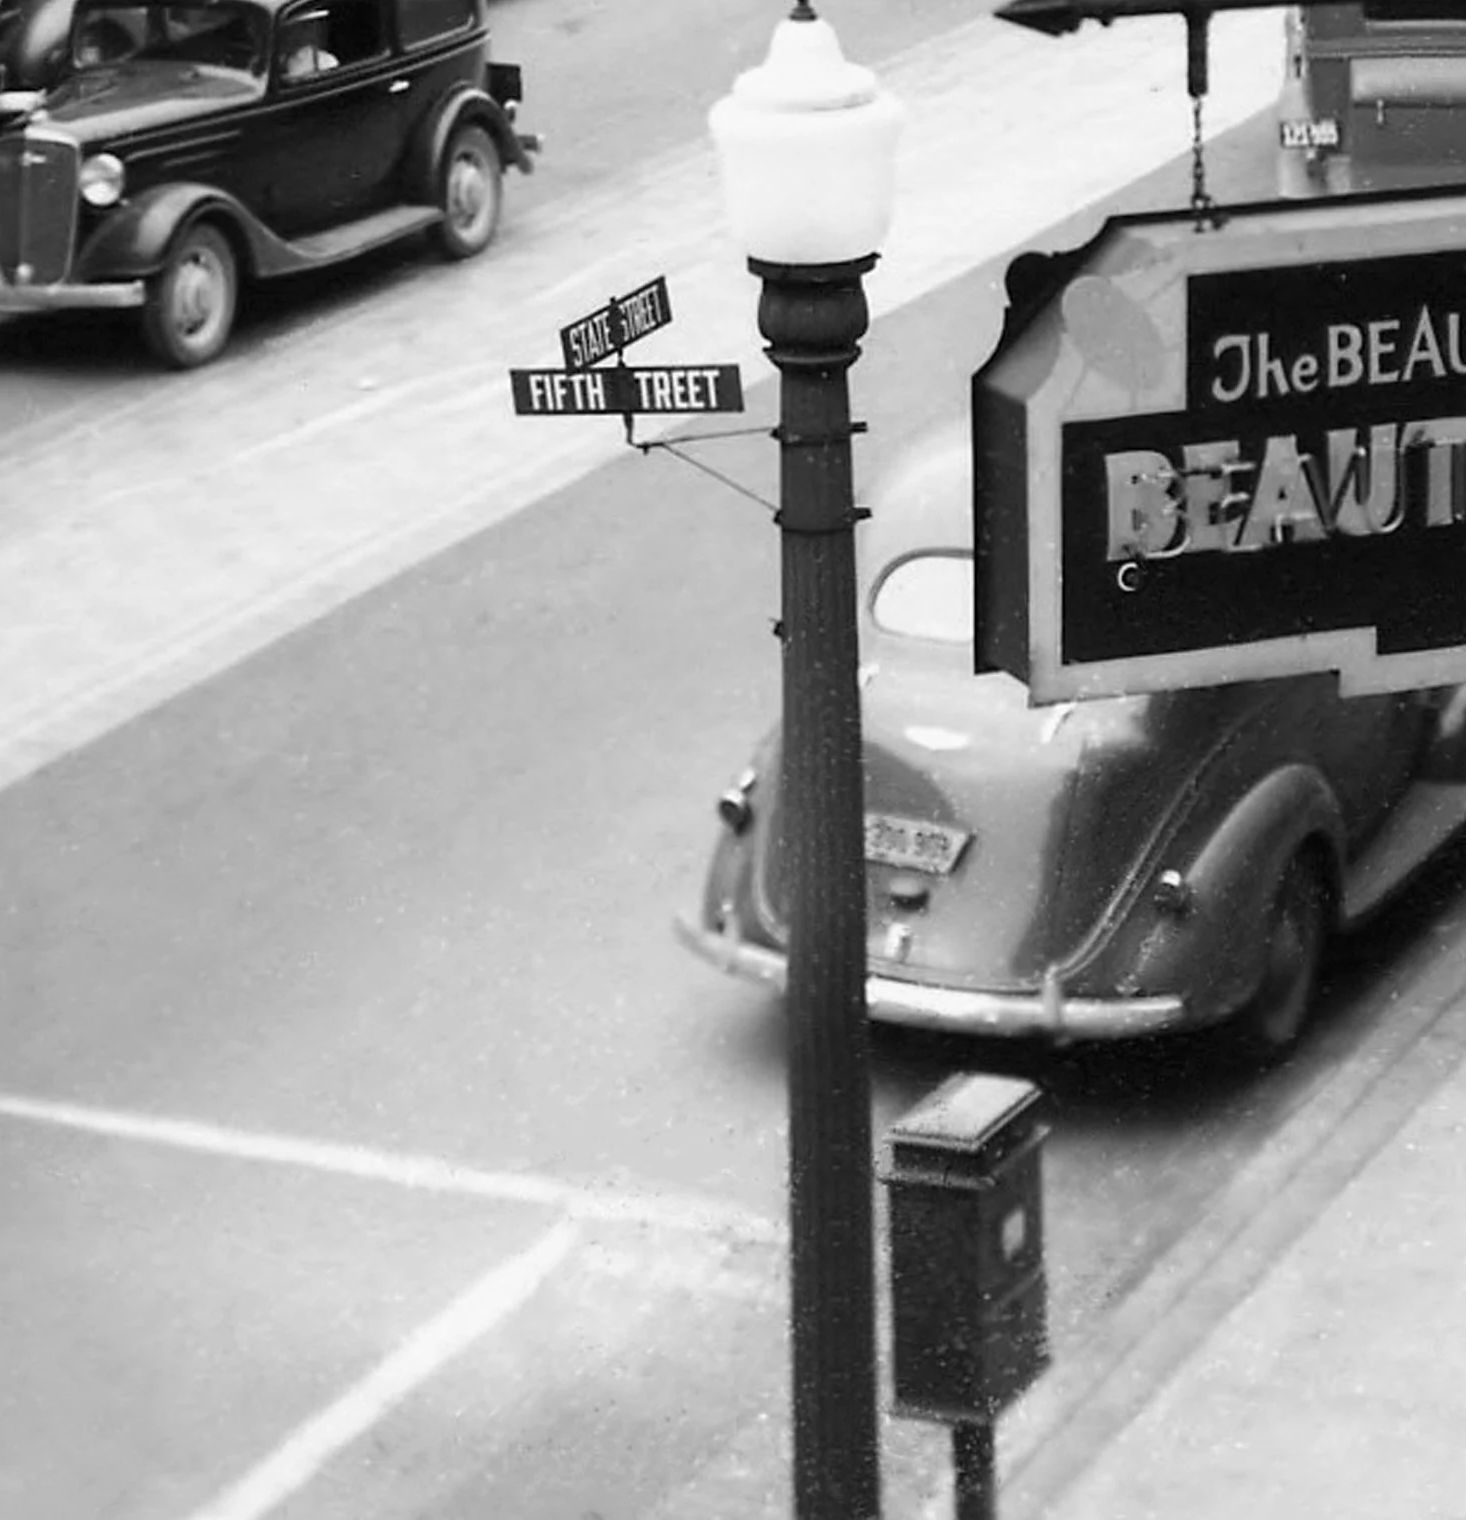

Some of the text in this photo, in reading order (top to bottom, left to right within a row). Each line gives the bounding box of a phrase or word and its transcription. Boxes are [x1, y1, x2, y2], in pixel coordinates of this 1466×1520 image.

[569, 284, 663, 368] STATE STREET
[529, 369, 720, 411] FIFTH TREET
[1212, 333, 1319, 402] The
